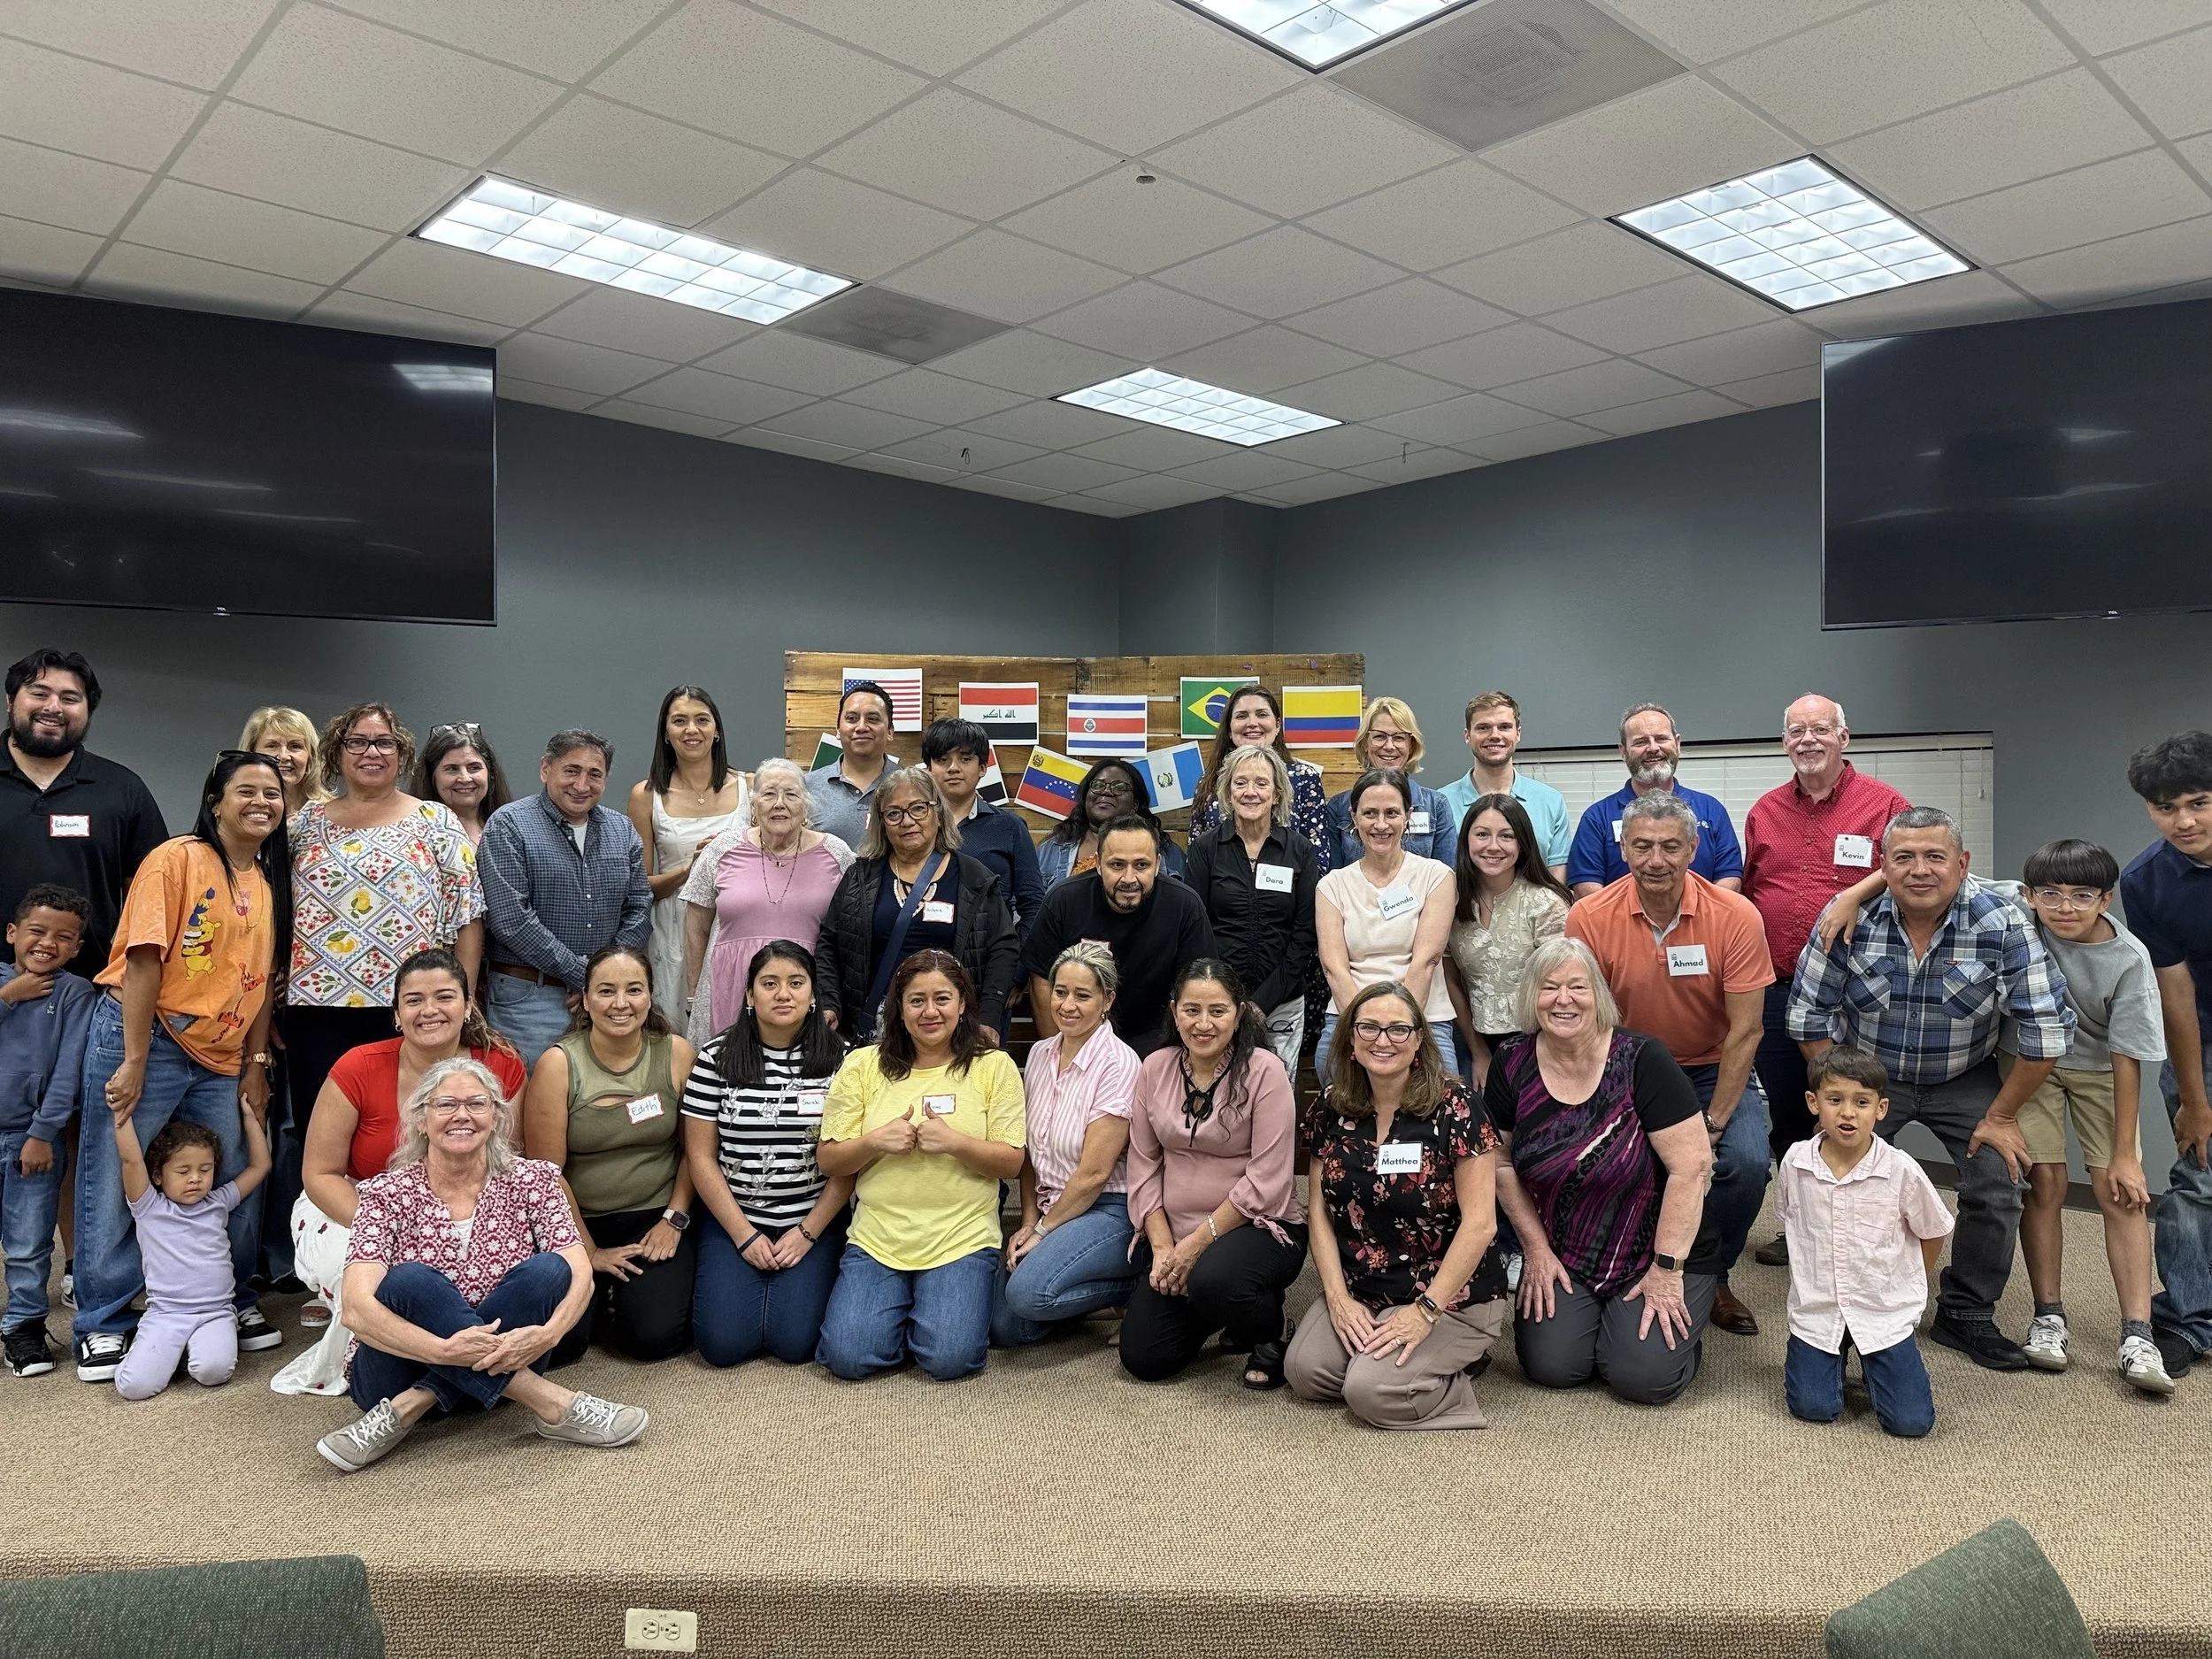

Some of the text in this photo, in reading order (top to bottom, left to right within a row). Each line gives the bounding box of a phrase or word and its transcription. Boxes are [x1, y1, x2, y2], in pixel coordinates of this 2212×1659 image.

[1842, 851, 1864, 860] Kevin
[1265, 876, 1284, 885] Dara
[1383, 895, 1414, 912] Gwenda
[1673, 958, 1704, 967] Ahmad
[631, 1100, 658, 1117] Edith
[1381, 1156, 1418, 1166] Matthea
